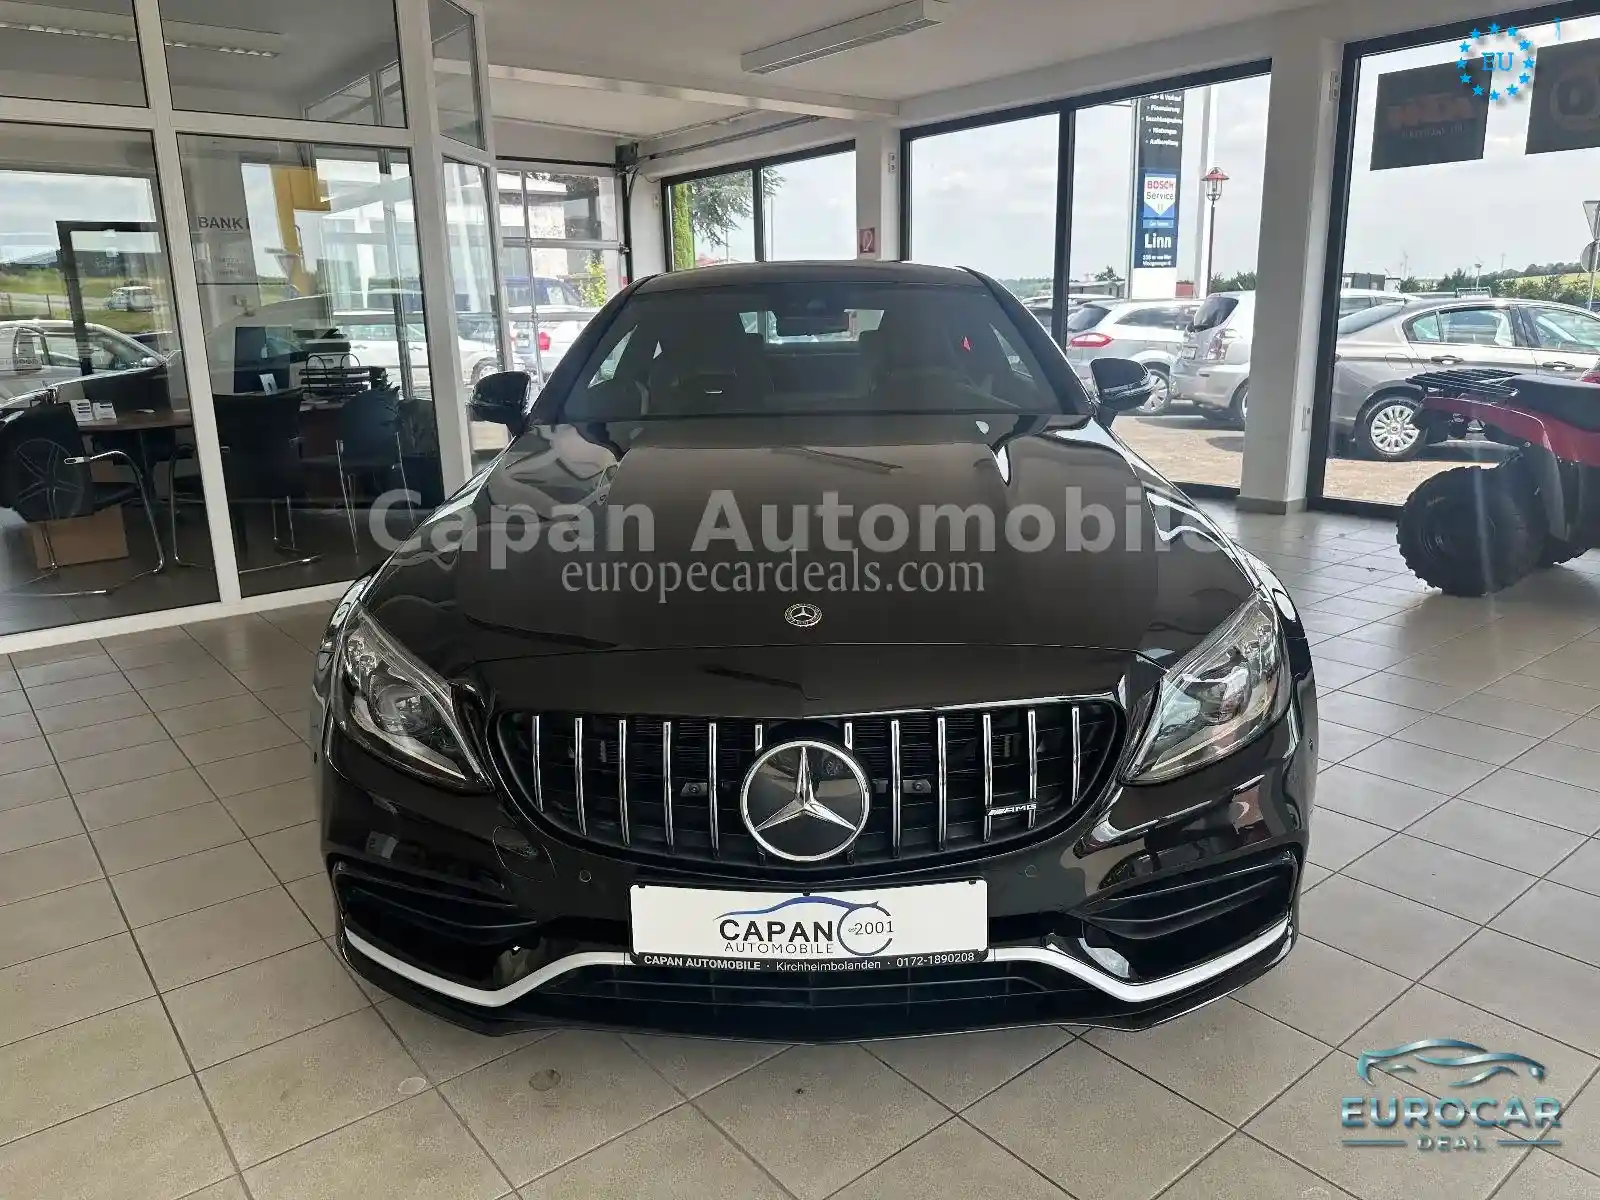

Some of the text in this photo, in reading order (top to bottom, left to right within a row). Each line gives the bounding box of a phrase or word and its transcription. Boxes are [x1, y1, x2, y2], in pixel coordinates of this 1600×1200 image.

[1147, 180, 1174, 189] BOSCH
[1146, 191, 1174, 201] Service
[1144, 232, 1172, 249] Linn
[719, 918, 834, 943] CAPAN
[854, 920, 895, 936] 2001
[724, 941, 835, 954] AUTOMOBILE
[643, 952, 975, 972] CAPAN AUTOMOBILE Kirchheimbolanden 0172-1890208
